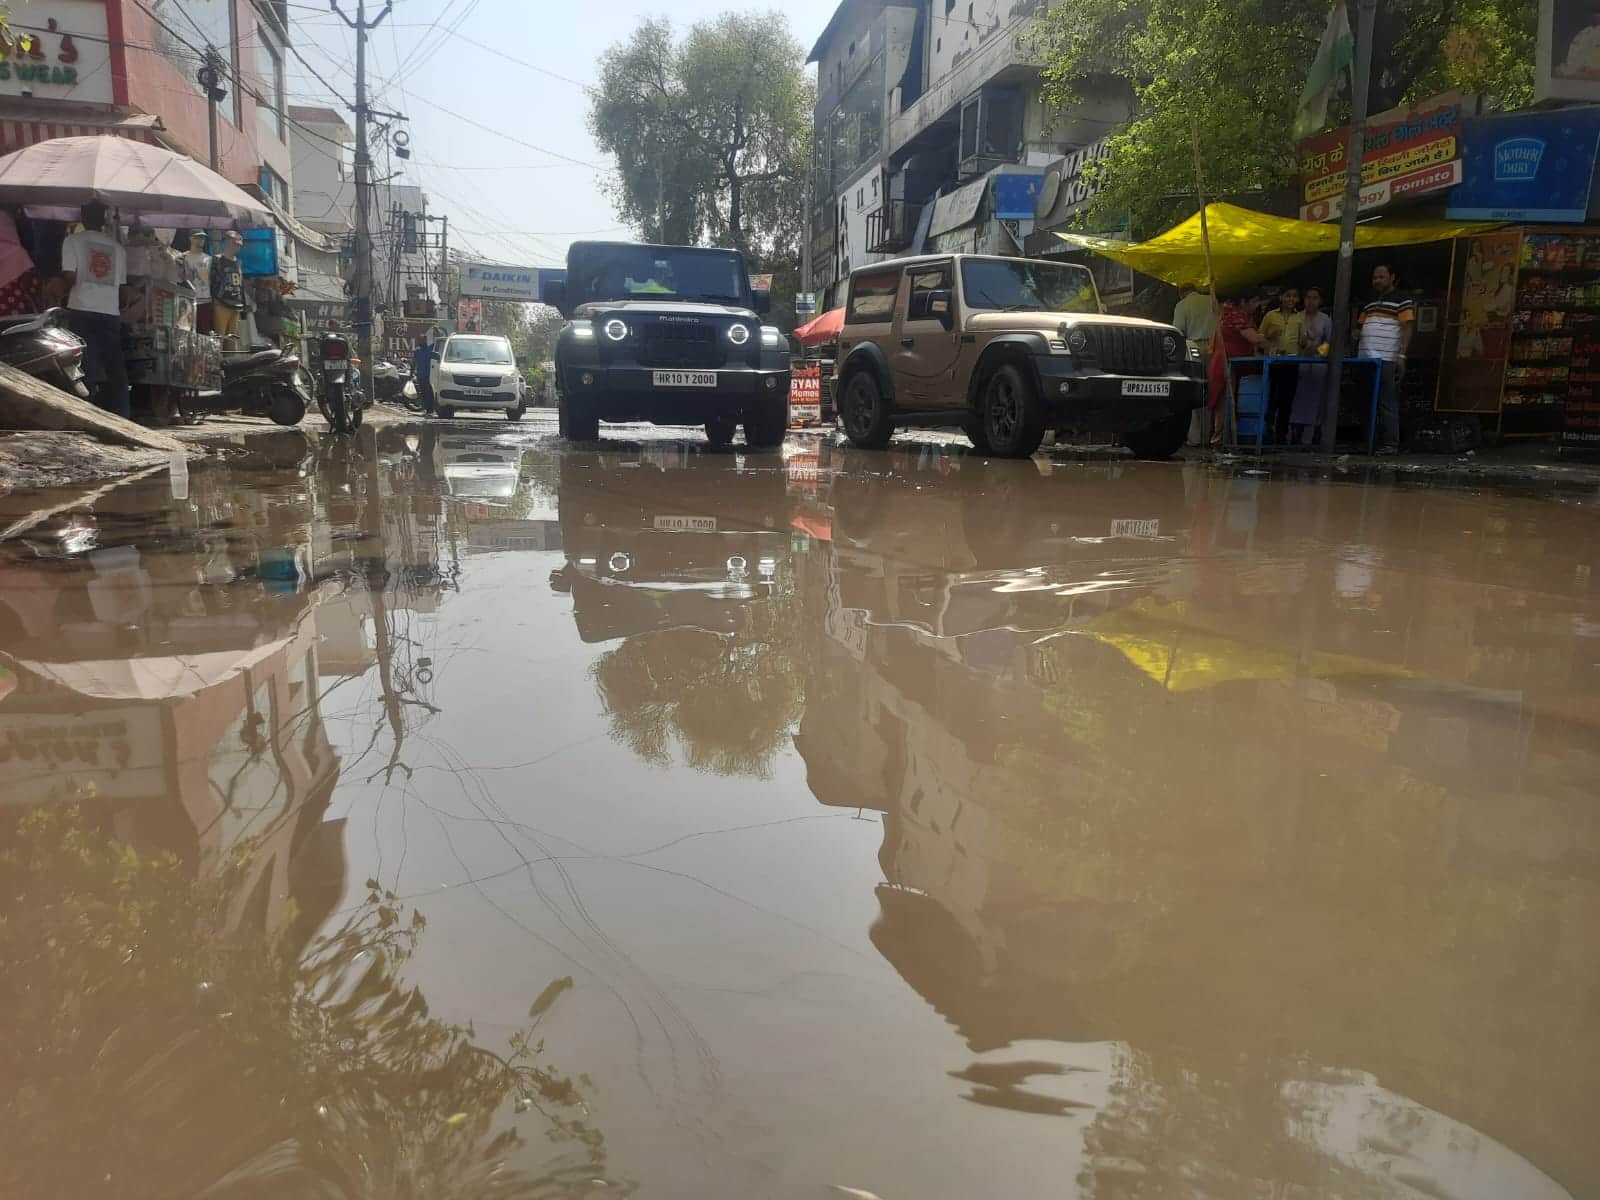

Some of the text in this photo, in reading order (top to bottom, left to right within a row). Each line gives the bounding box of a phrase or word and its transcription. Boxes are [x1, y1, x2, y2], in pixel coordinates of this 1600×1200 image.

[1394, 171, 1450, 193] zomato
[482, 272, 530, 281] DAIKIN
[389, 337, 416, 351] HM
[791, 379, 820, 390] GYAN
